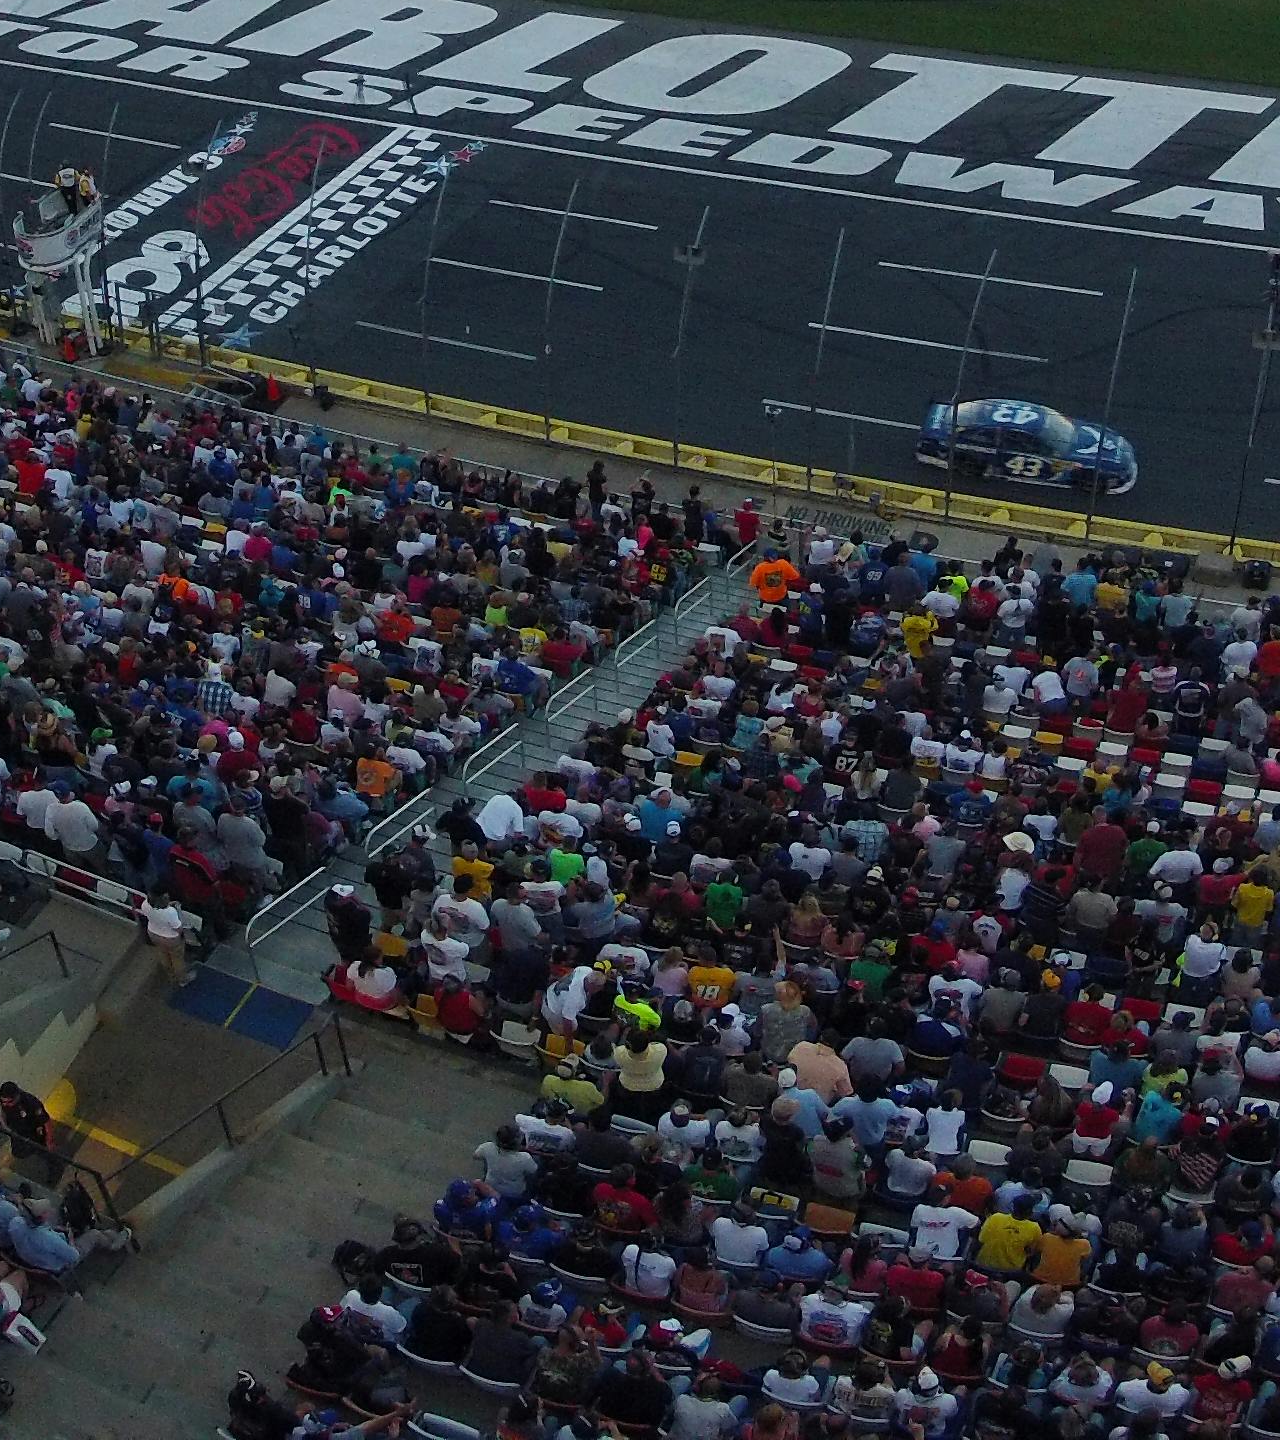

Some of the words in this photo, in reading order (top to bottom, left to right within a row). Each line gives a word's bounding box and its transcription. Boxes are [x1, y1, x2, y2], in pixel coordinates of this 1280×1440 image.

[249, 173, 438, 324] CHARLOTTE
[1006, 456, 1043, 477] 43
[834, 755, 859, 773] 87
[695, 984, 721, 1001] 18
